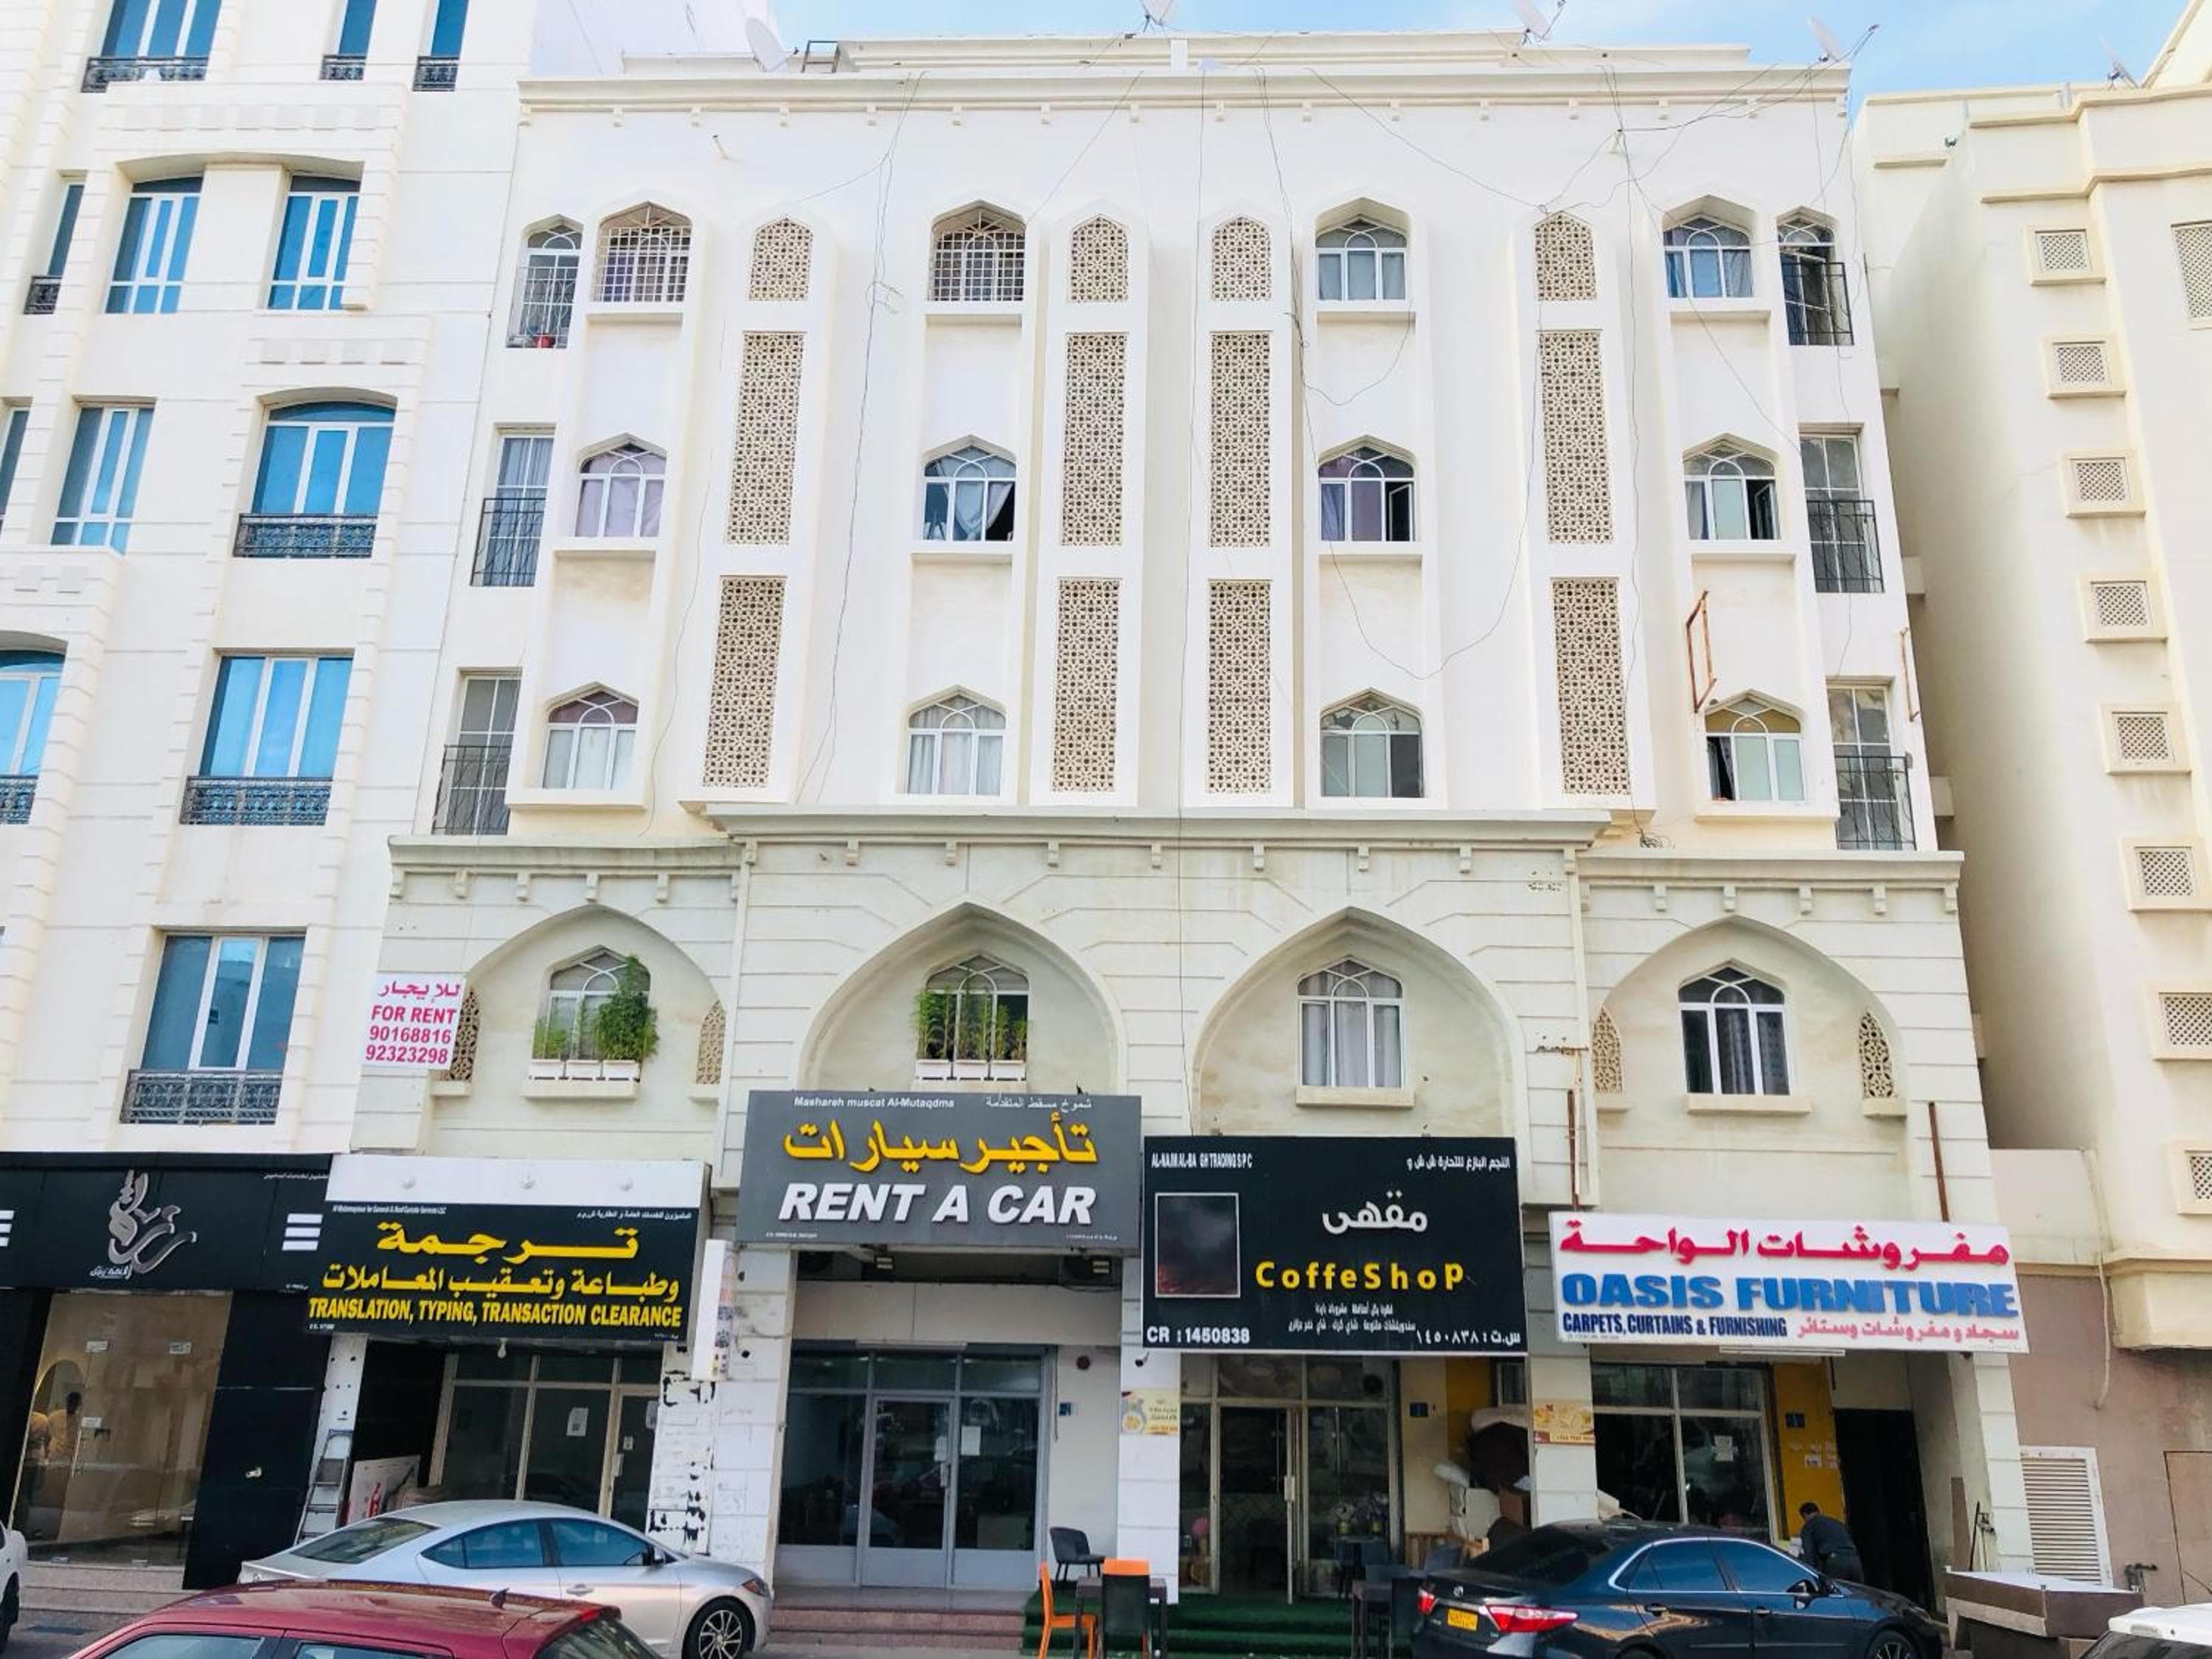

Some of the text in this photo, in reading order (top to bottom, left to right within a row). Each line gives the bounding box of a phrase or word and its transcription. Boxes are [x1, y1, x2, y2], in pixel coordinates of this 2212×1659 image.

[372, 1005, 456, 1024] FOR RENT
[369, 1026, 451, 1044] 90168816
[366, 1044, 448, 1064] 92323298
[1027, 1096, 1057, 1108] مسقط
[783, 1111, 1098, 1174] تأجير سيارات
[778, 1183, 1097, 1225] RENT A CAR
[1321, 1189, 1428, 1235] مقهى
[377, 1221, 639, 1265] ترجمة
[1559, 1219, 2011, 1272] مفروشات الواحة
[322, 1262, 680, 1303] وطباعة وتعقيب المعاملات
[1561, 1273, 2019, 1318] OASIS FURNITURE
[309, 1298, 683, 1327] TRANSLATION, TYPING, TRANSACTION CLEARANCE
[1627, 1313, 1692, 1335] CURTAINS
[1697, 1318, 1707, 1335] &
[1708, 1315, 1788, 1338] FURNISHING
[1147, 1325, 1170, 1343] CR
